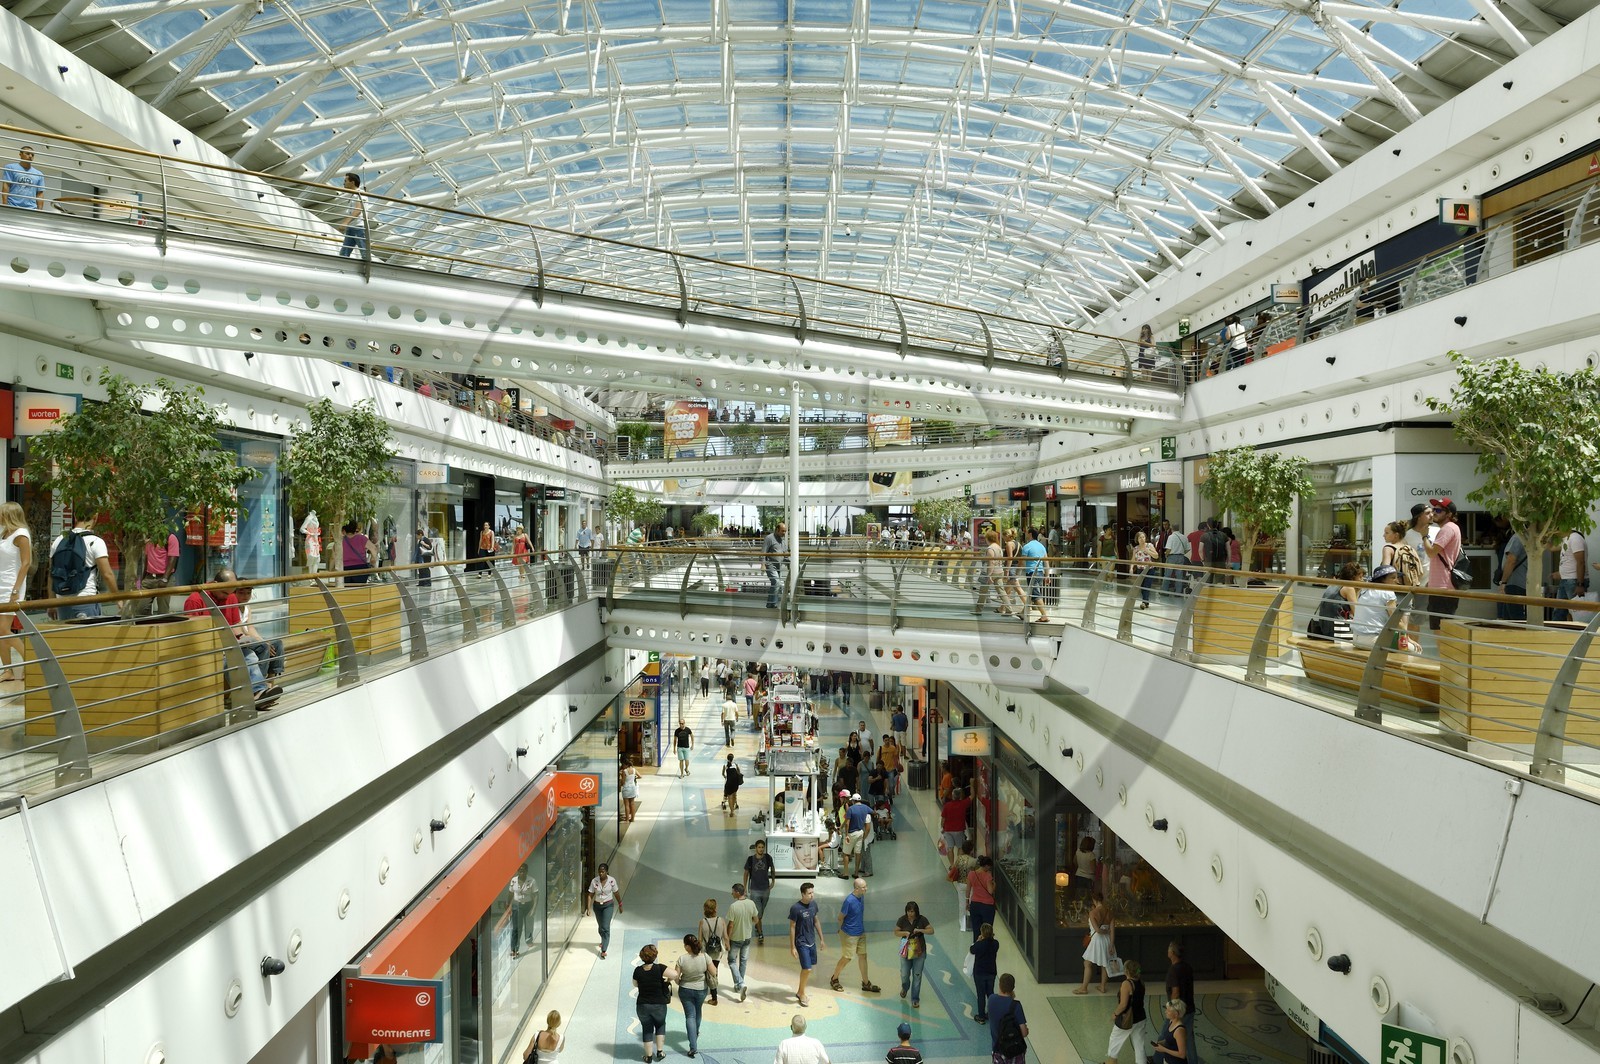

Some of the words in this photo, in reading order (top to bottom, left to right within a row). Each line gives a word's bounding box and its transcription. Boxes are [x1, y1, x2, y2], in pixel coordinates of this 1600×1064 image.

[31, 410, 57, 418] worten
[1410, 487, 1434, 496] Calvin
[1434, 487, 1453, 496] Klein
[559, 790, 597, 800] GeoStar
[1300, 1002, 1310, 1016] WC
[1287, 1007, 1310, 1032] CINEMAS
[371, 1028, 431, 1038] CONTINENTE
